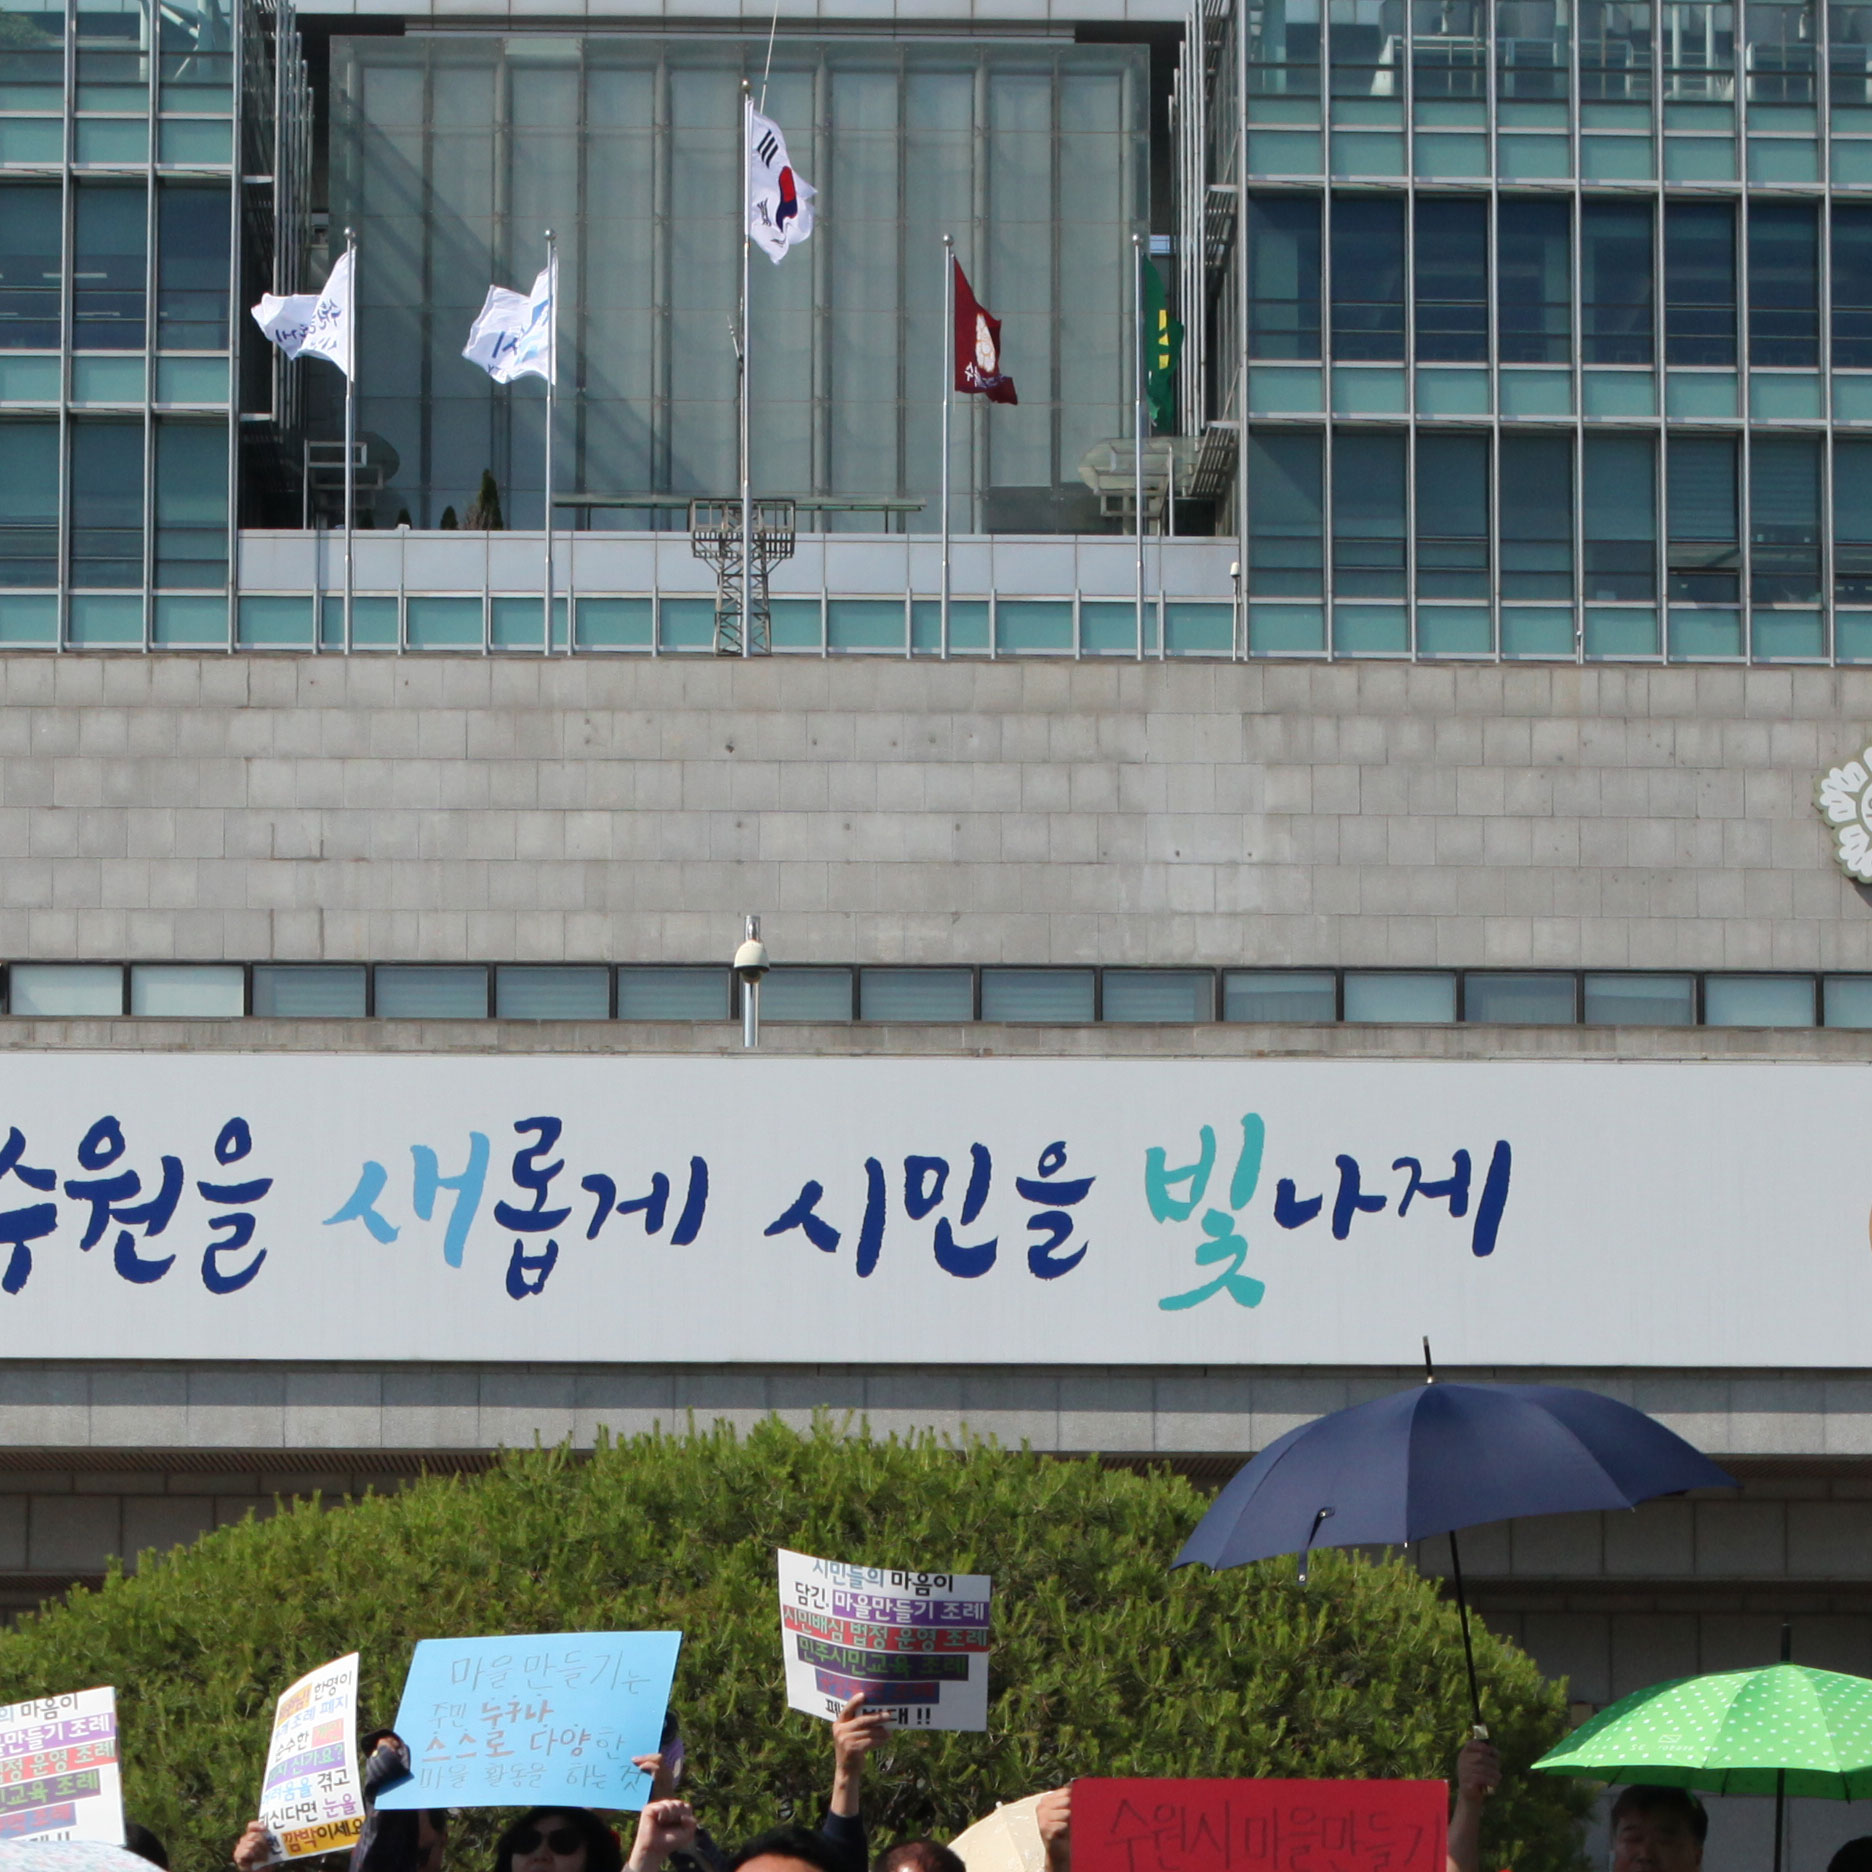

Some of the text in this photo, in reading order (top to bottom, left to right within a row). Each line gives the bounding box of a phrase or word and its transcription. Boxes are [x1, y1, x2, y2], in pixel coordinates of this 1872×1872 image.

[326, 1116, 709, 1300] 새롭게
[764, 1138, 1097, 1282] 시민을
[1147, 1111, 1511, 1313] 빛나게
[812, 1560, 953, 1596] 시민들의 마음이
[835, 1591, 984, 1623] 마을만들기 조례
[851, 1623, 888, 1650] 법정
[20, 1694, 79, 1719] 마음이
[429, 1700, 554, 1727] 주민 누구나
[69, 1715, 112, 1739] 조례
[420, 1765, 469, 1790] 마을
